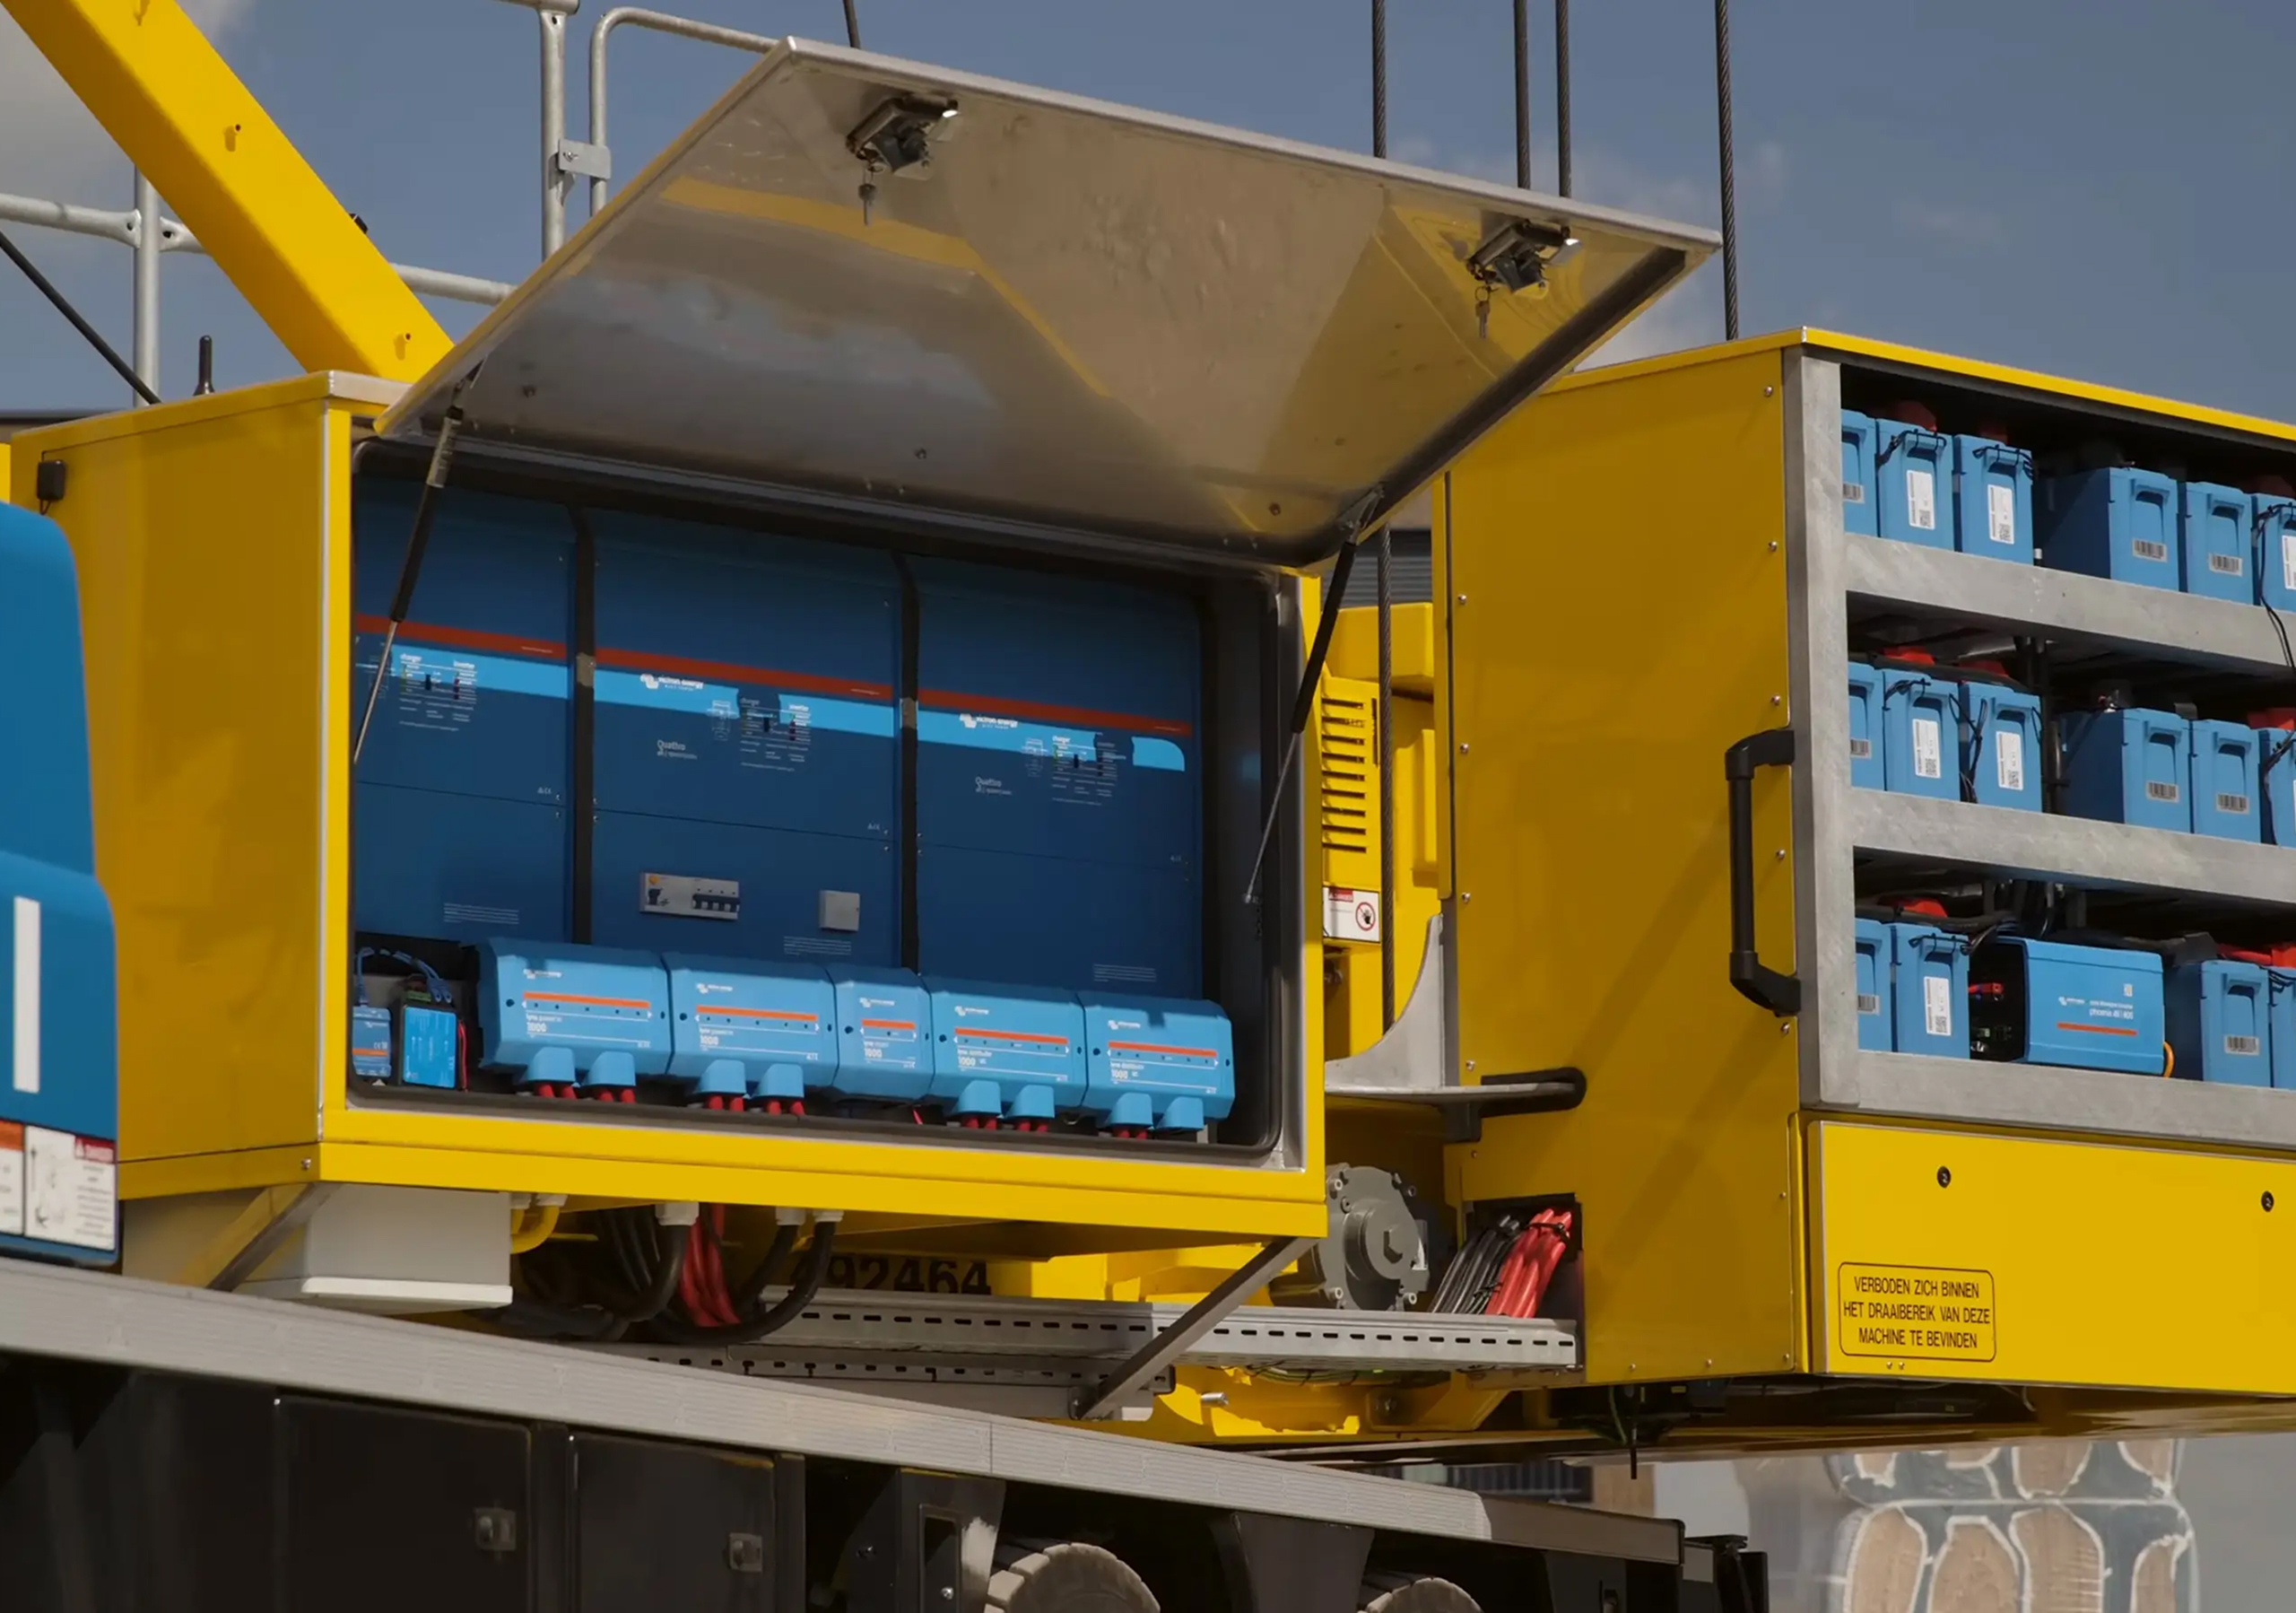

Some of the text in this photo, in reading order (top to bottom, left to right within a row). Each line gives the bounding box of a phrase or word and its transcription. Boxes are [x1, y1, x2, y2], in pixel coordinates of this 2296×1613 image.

[657, 739, 686, 752] Quattro
[975, 776, 1002, 788] Quattro
[1854, 1276, 1979, 1298] VERBODEN ZICH BINNEN
[1843, 1302, 1990, 1324] HET DRAAIBEREIK VAN DEZE
[1858, 1327, 1978, 1348] MACHINE TE BEVINDEN
